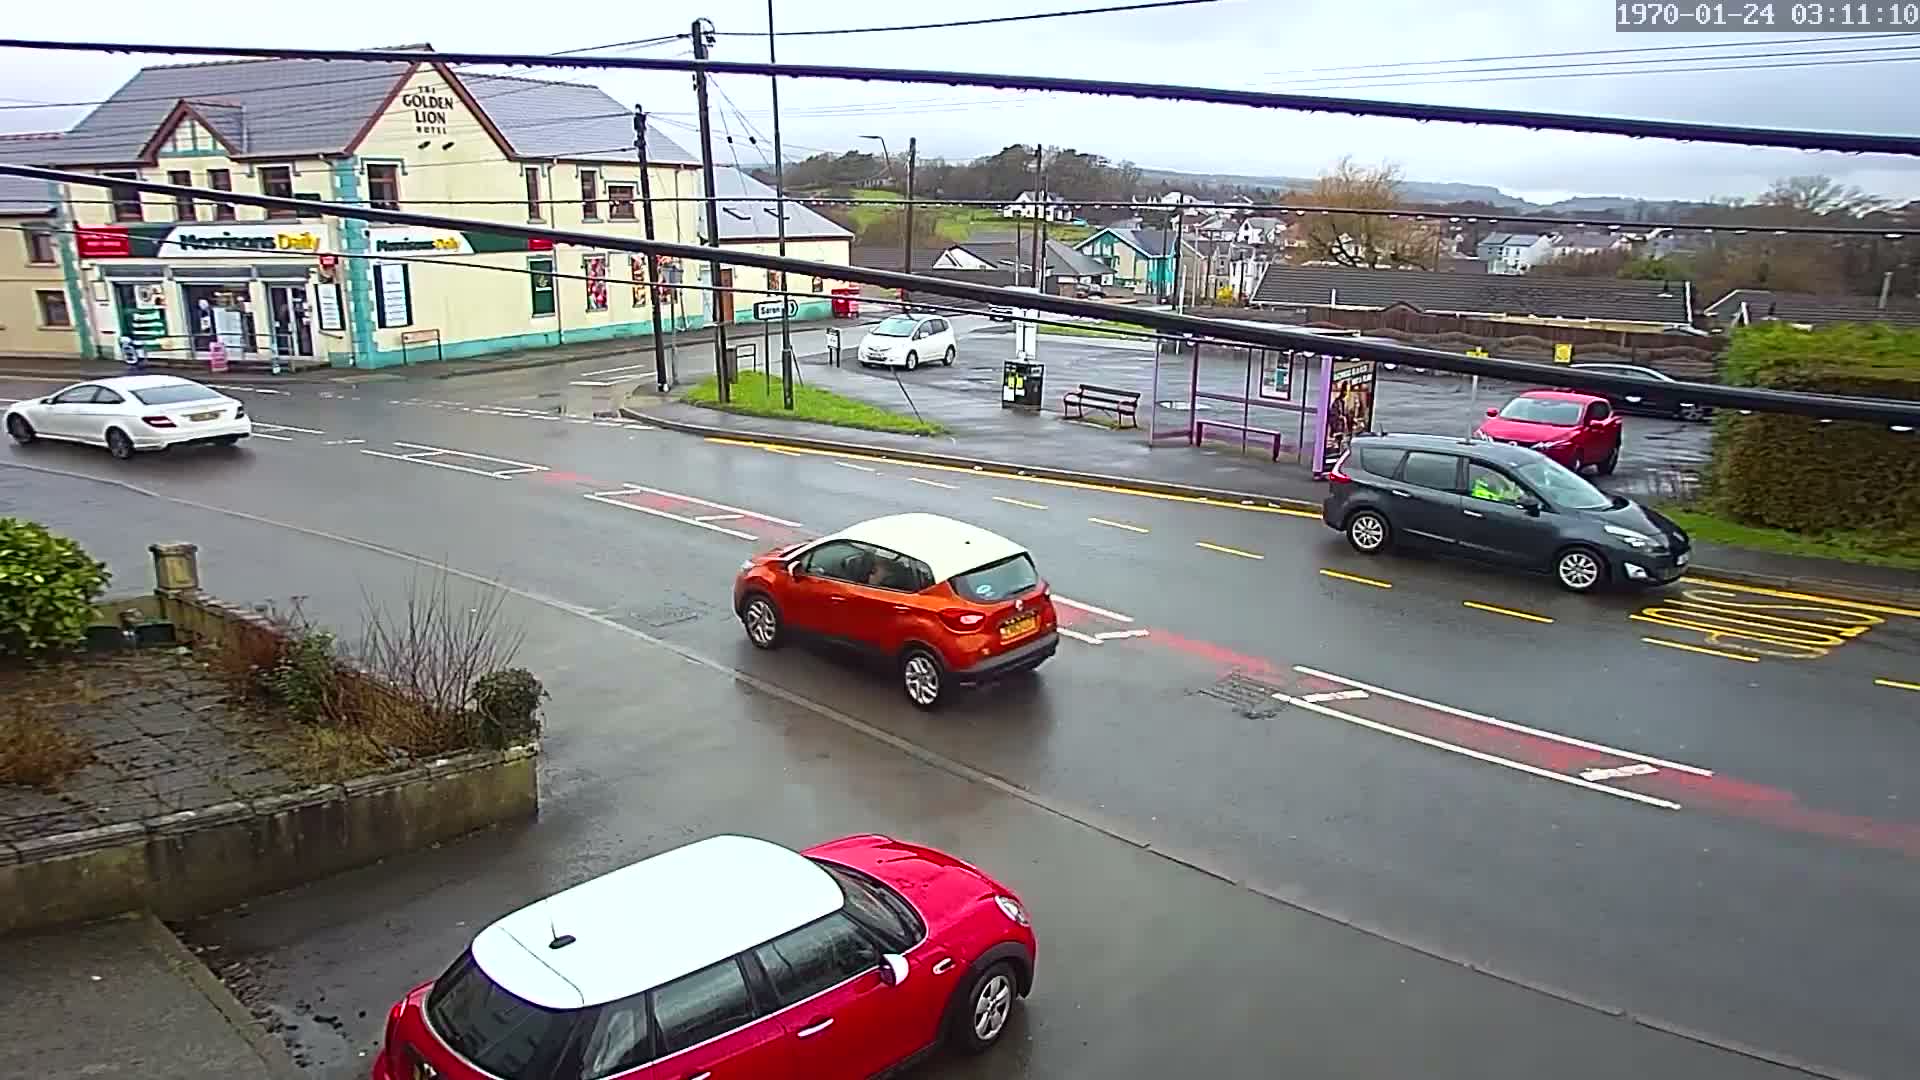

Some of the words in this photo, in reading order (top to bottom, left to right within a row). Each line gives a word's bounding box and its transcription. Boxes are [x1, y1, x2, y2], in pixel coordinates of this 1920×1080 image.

[402, 94, 453, 109] GOLDEN
[415, 109, 446, 124] LION
[179, 231, 275, 251] Morrisons
[276, 231, 320, 252] Daily
